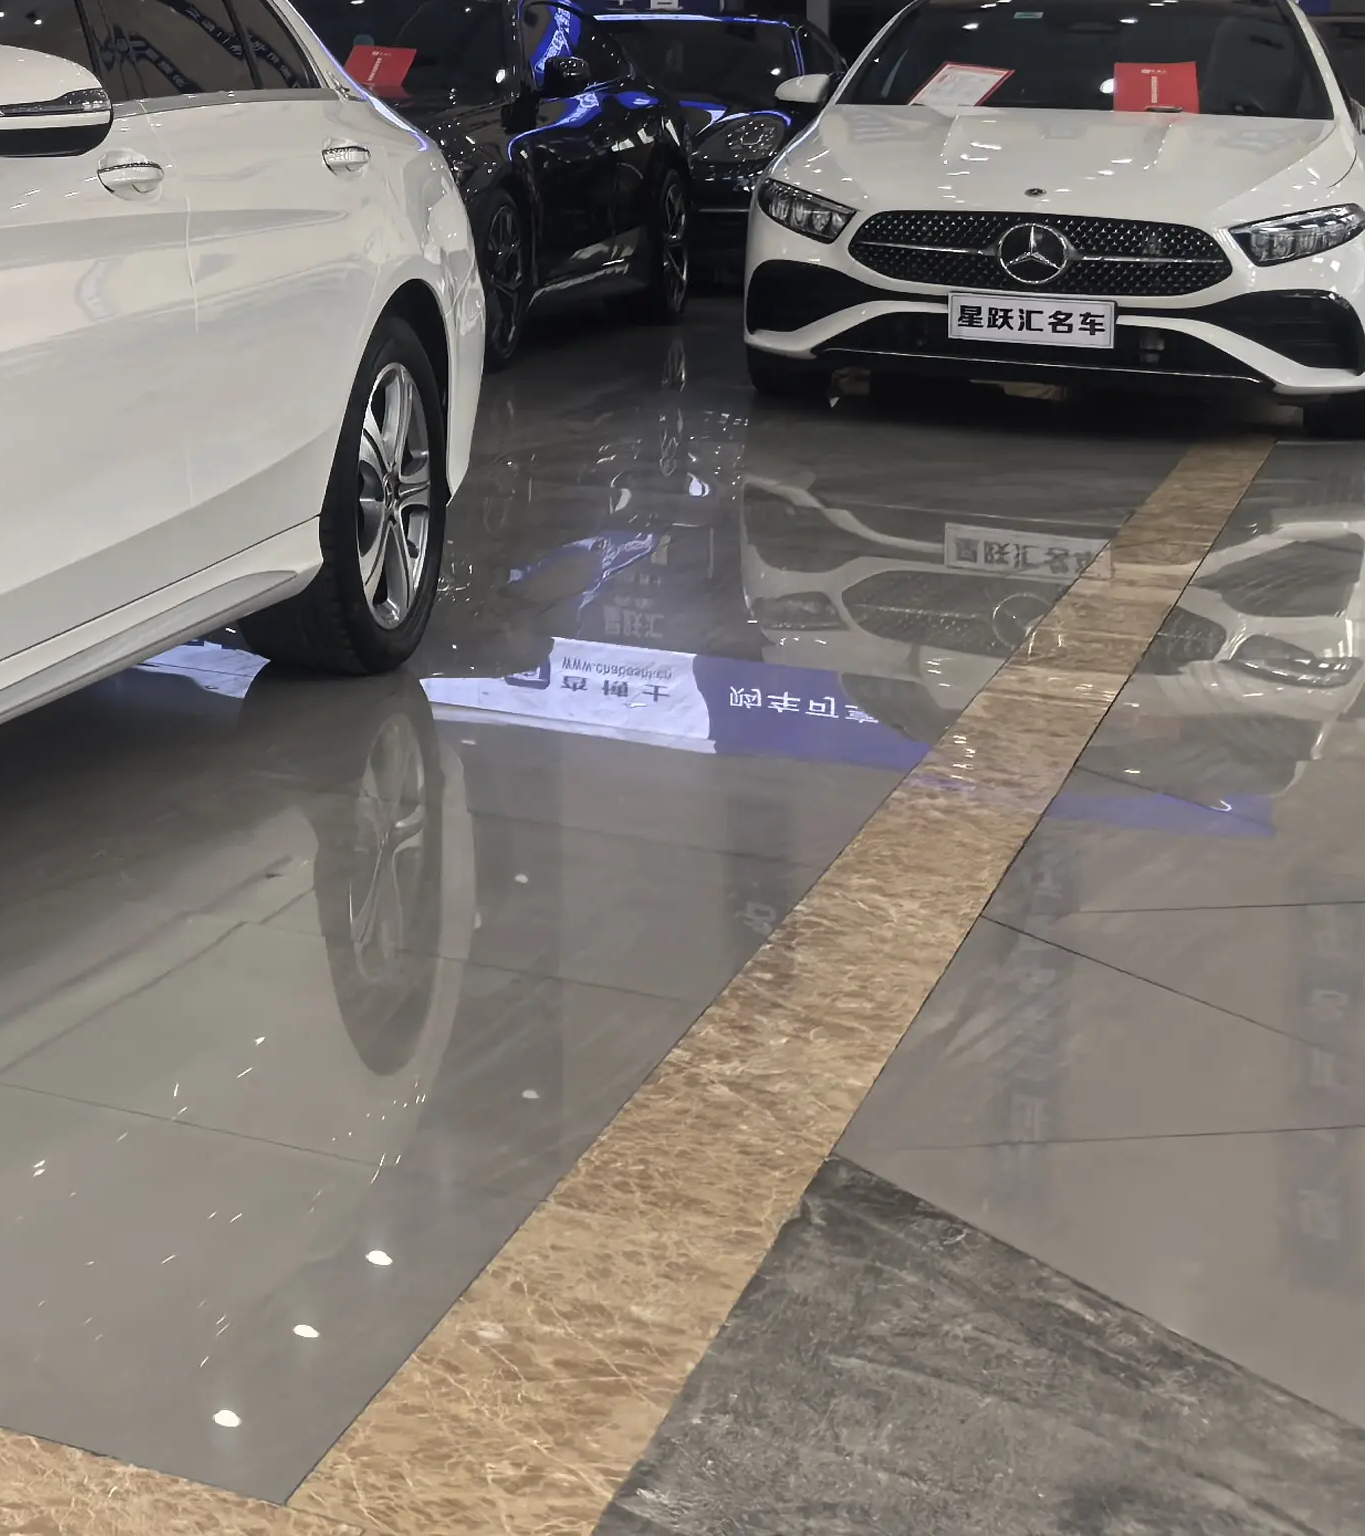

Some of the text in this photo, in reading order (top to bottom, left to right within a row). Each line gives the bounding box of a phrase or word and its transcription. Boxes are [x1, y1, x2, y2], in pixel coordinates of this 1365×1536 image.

[957, 305, 1106, 336] 星跃汇名车
